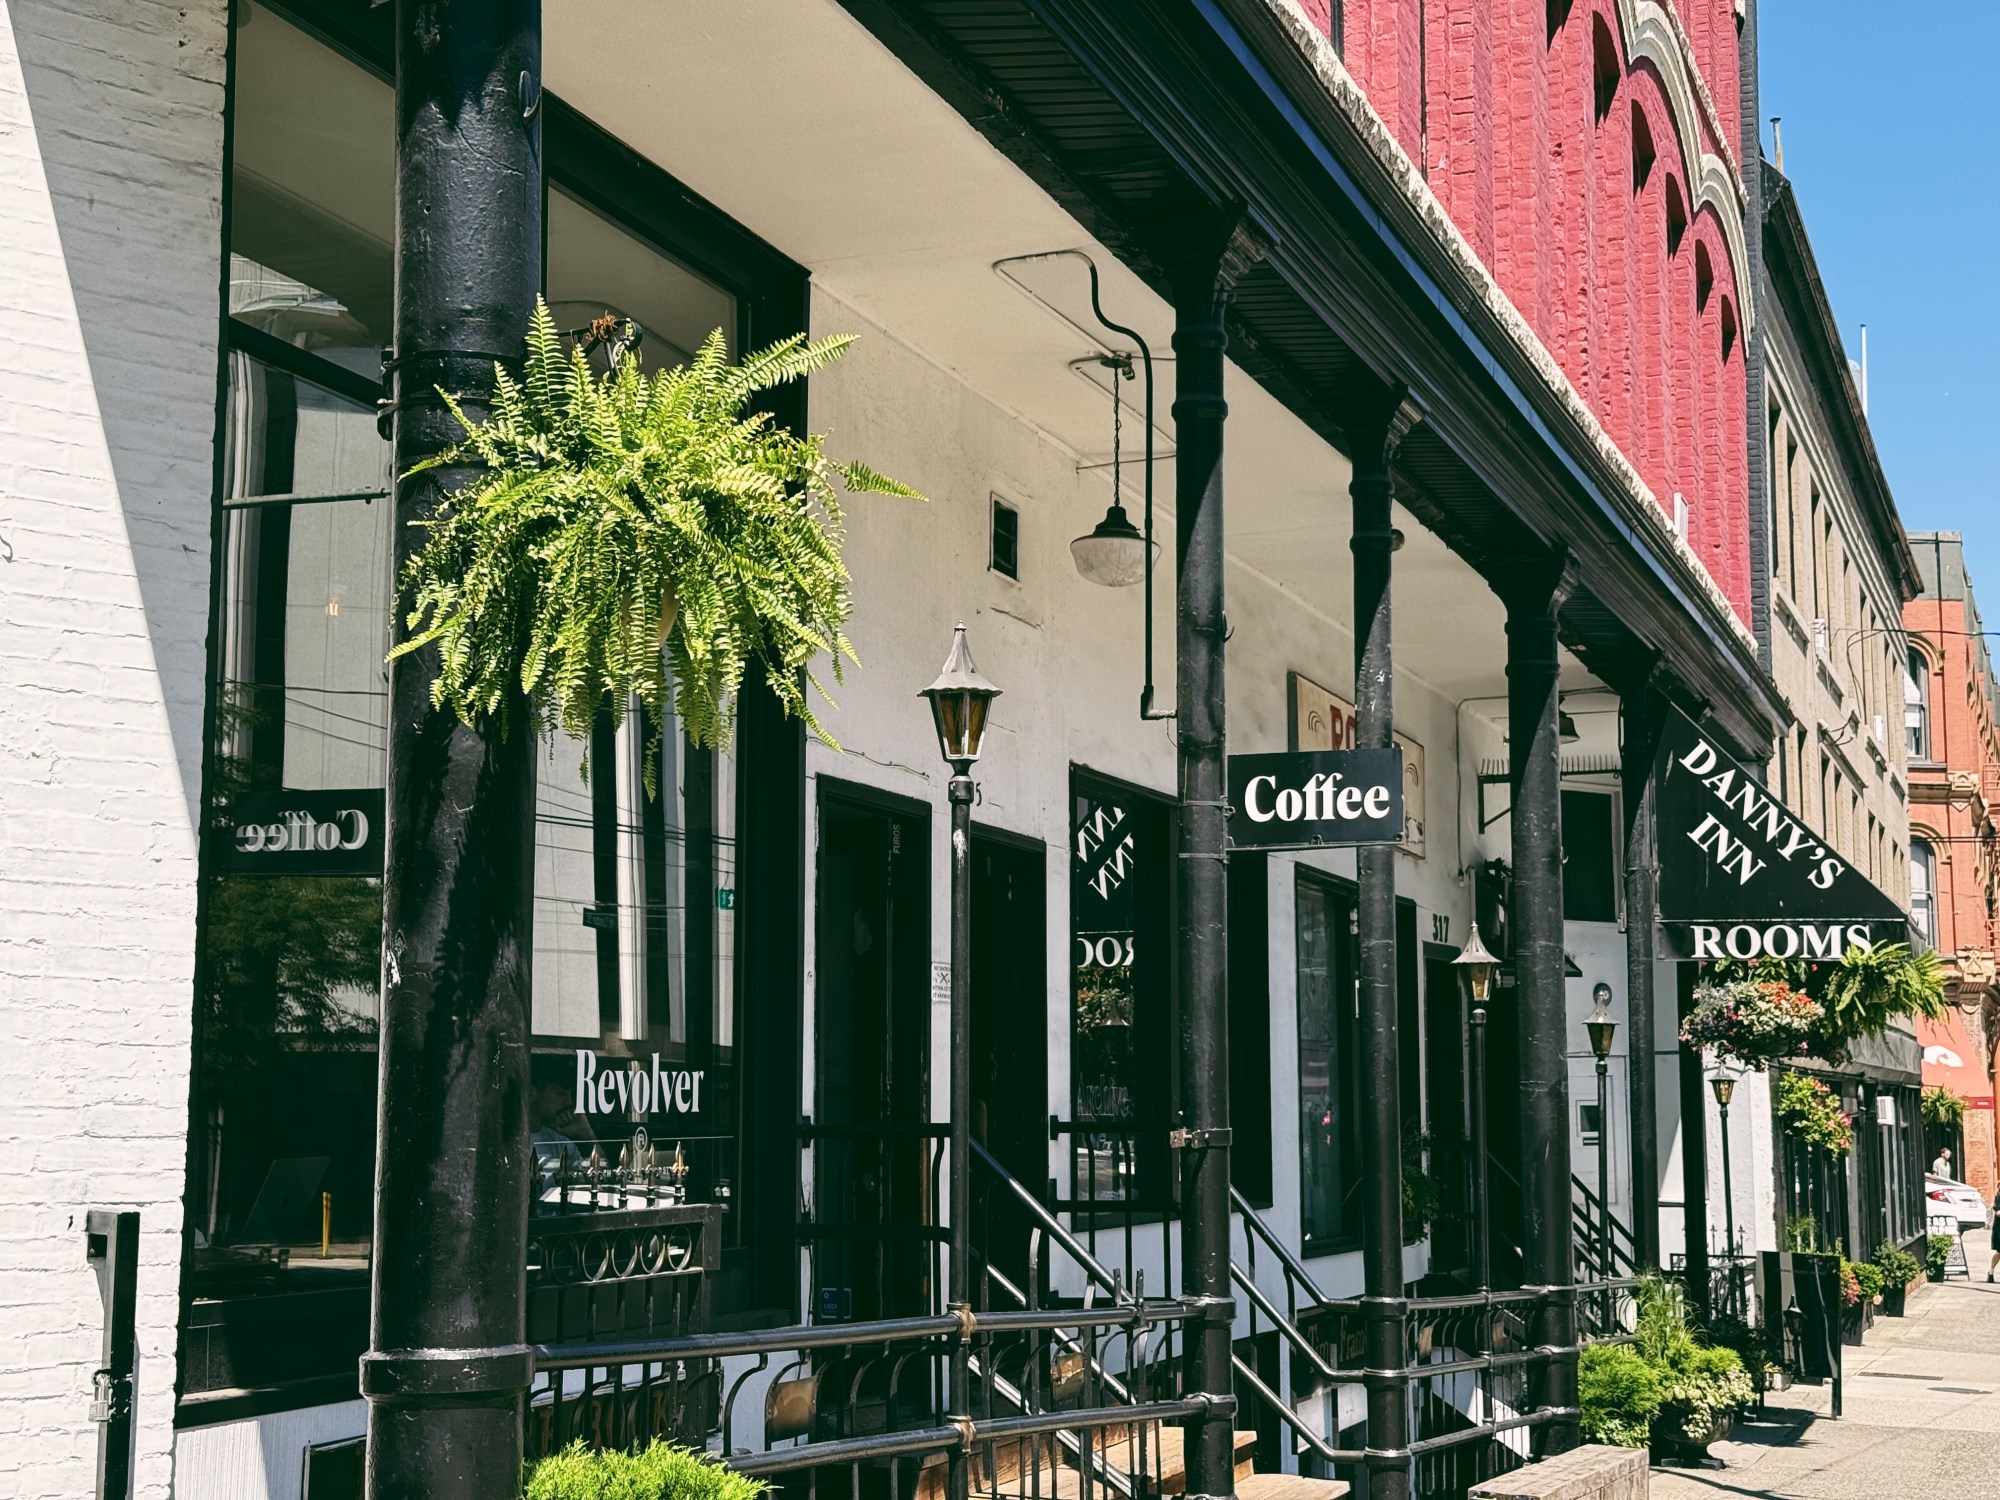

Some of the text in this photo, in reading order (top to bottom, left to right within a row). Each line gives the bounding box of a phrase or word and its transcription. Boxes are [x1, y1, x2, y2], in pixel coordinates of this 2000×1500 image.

[1244, 772, 1390, 822] Coffee
[1679, 739, 1845, 889] DANNY'S
[1687, 812, 1767, 886] INN
[1432, 912, 1450, 943] 317
[1690, 924, 1871, 959] ROOMS
[574, 1049, 705, 1114] Revolver
